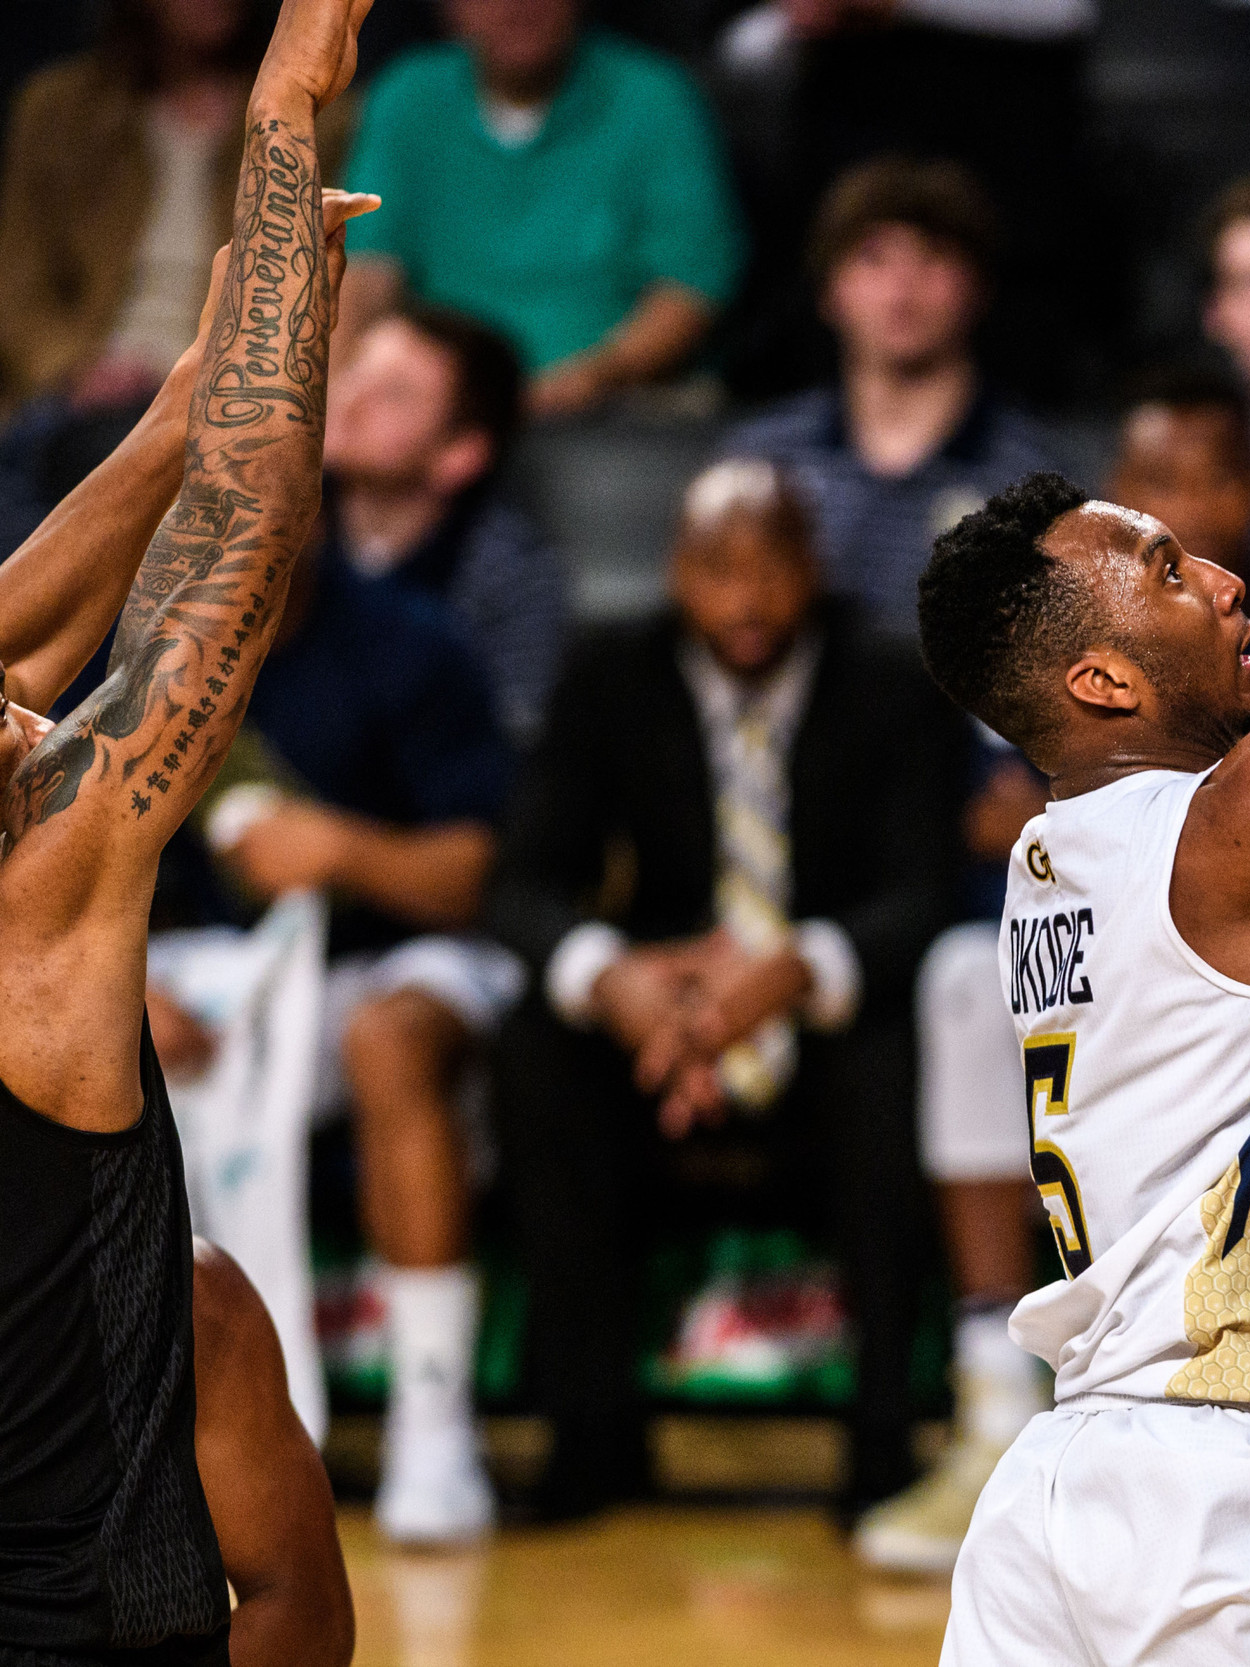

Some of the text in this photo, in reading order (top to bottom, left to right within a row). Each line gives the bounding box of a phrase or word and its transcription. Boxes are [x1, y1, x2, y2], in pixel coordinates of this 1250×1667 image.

[205, 146, 308, 428] Perseverance
[1011, 907, 1095, 1015] OKOGIE
[1023, 1031, 1095, 1281] 5
